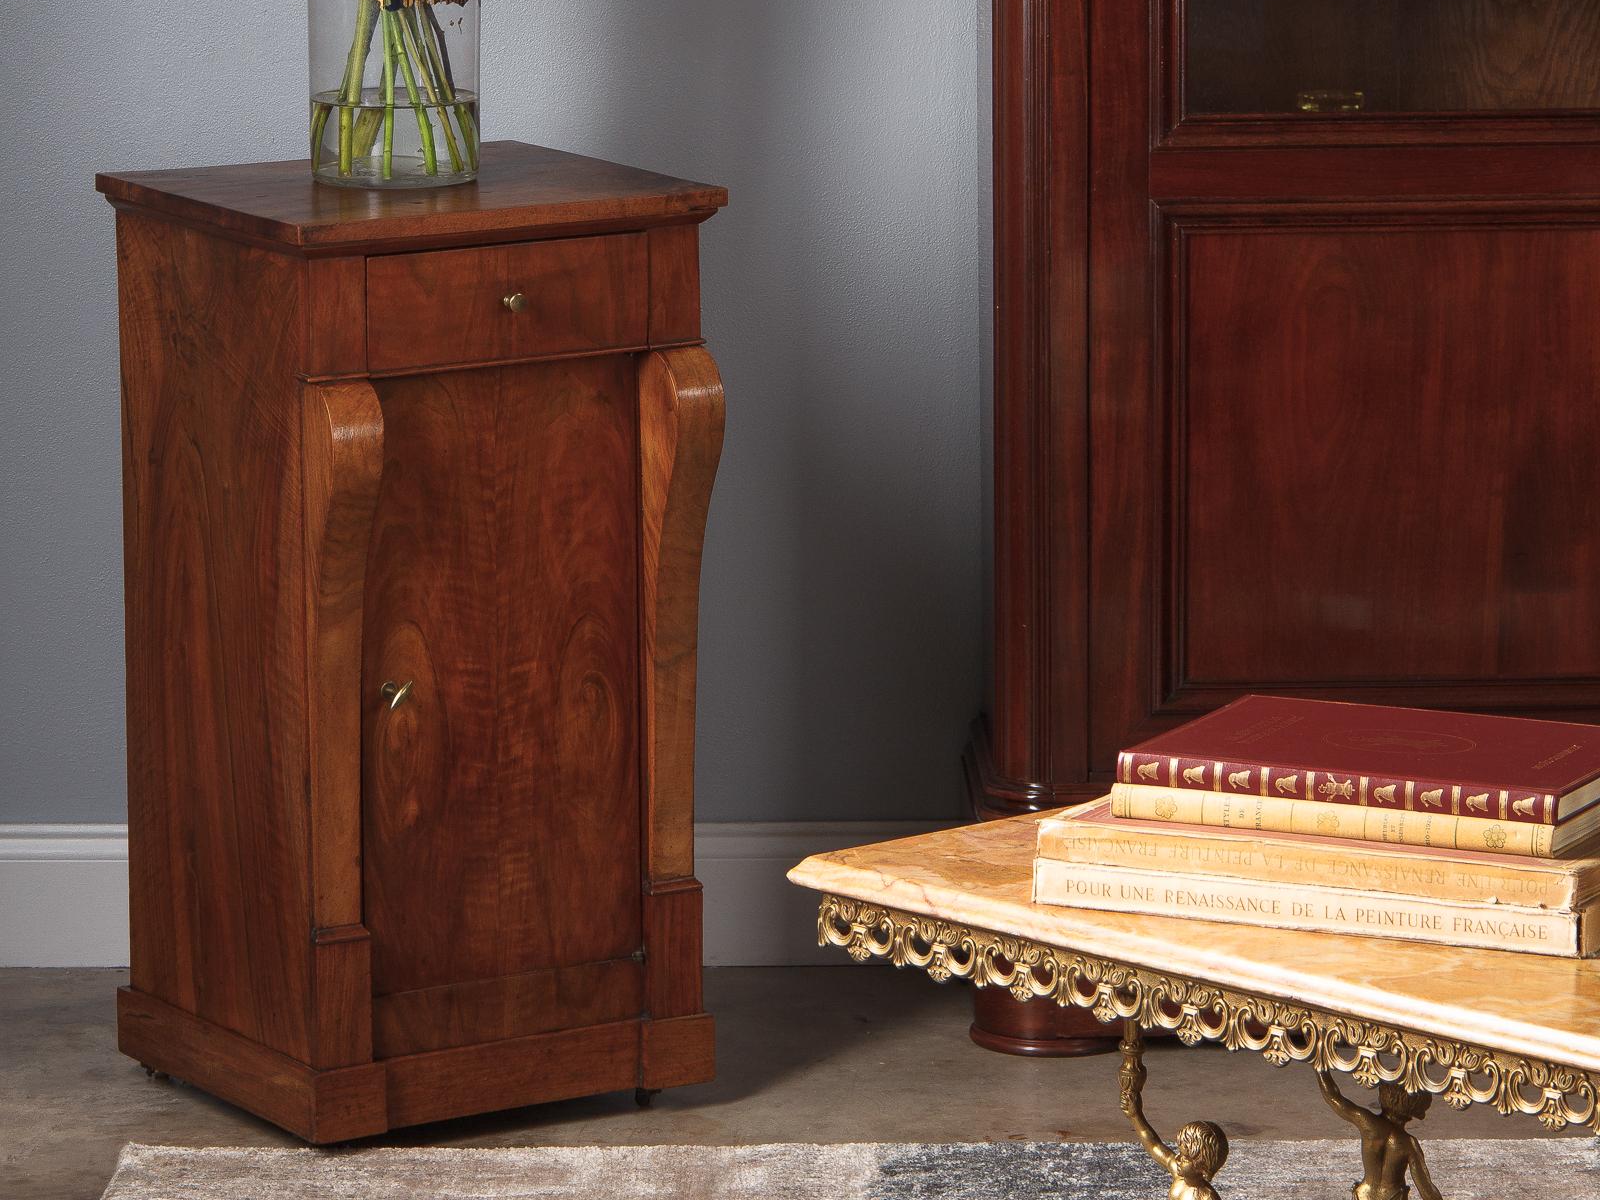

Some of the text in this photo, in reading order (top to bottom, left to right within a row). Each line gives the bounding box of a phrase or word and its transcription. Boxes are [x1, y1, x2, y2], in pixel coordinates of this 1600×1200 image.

[1168, 844, 1252, 866] PEINTURE
[1263, 855, 1282, 869] LA
[1066, 879, 1548, 940] POUR UNE RENAISSANCE DE LA PEINTURE FRANÇAISE
